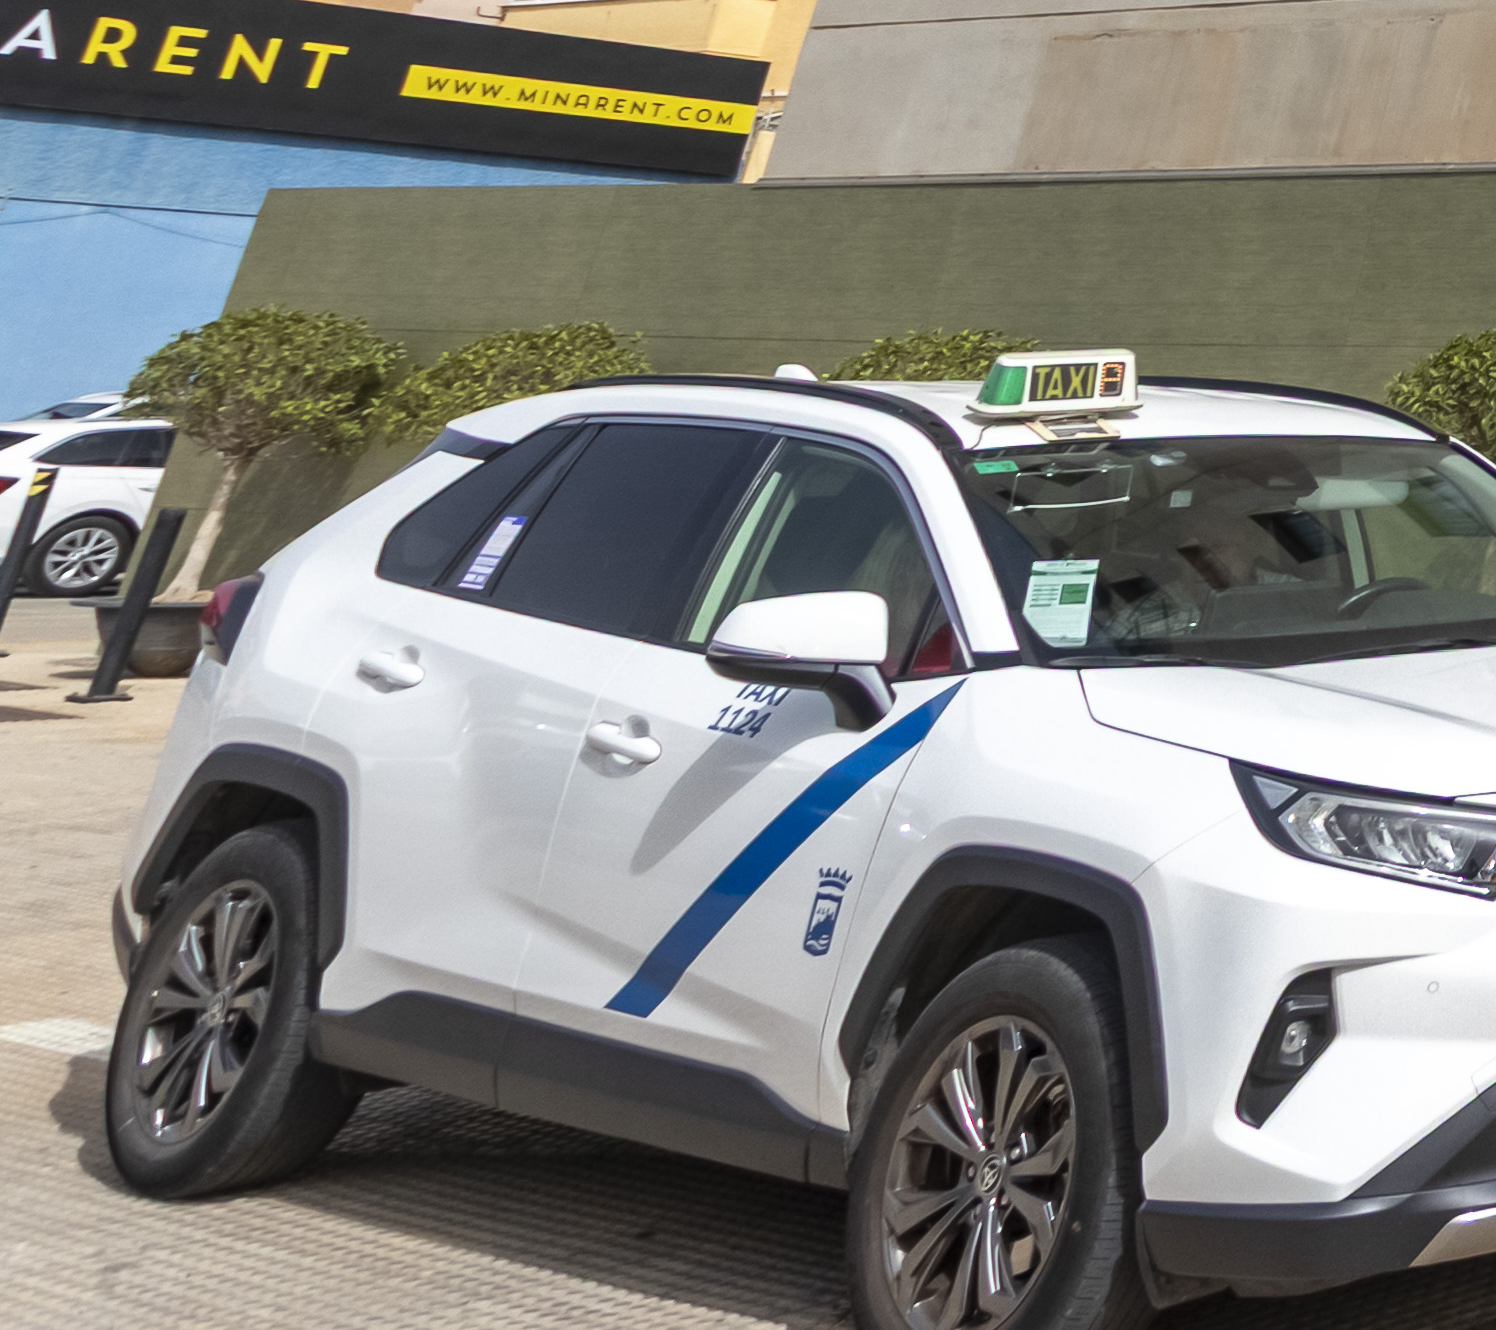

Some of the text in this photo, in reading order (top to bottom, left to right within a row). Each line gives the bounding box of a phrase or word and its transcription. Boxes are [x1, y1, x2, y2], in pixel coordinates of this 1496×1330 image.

[426, 76, 735, 126] WWW.MINARENT.COM
[1035, 365, 1095, 399] TAXI
[707, 705, 772, 738] 1124
